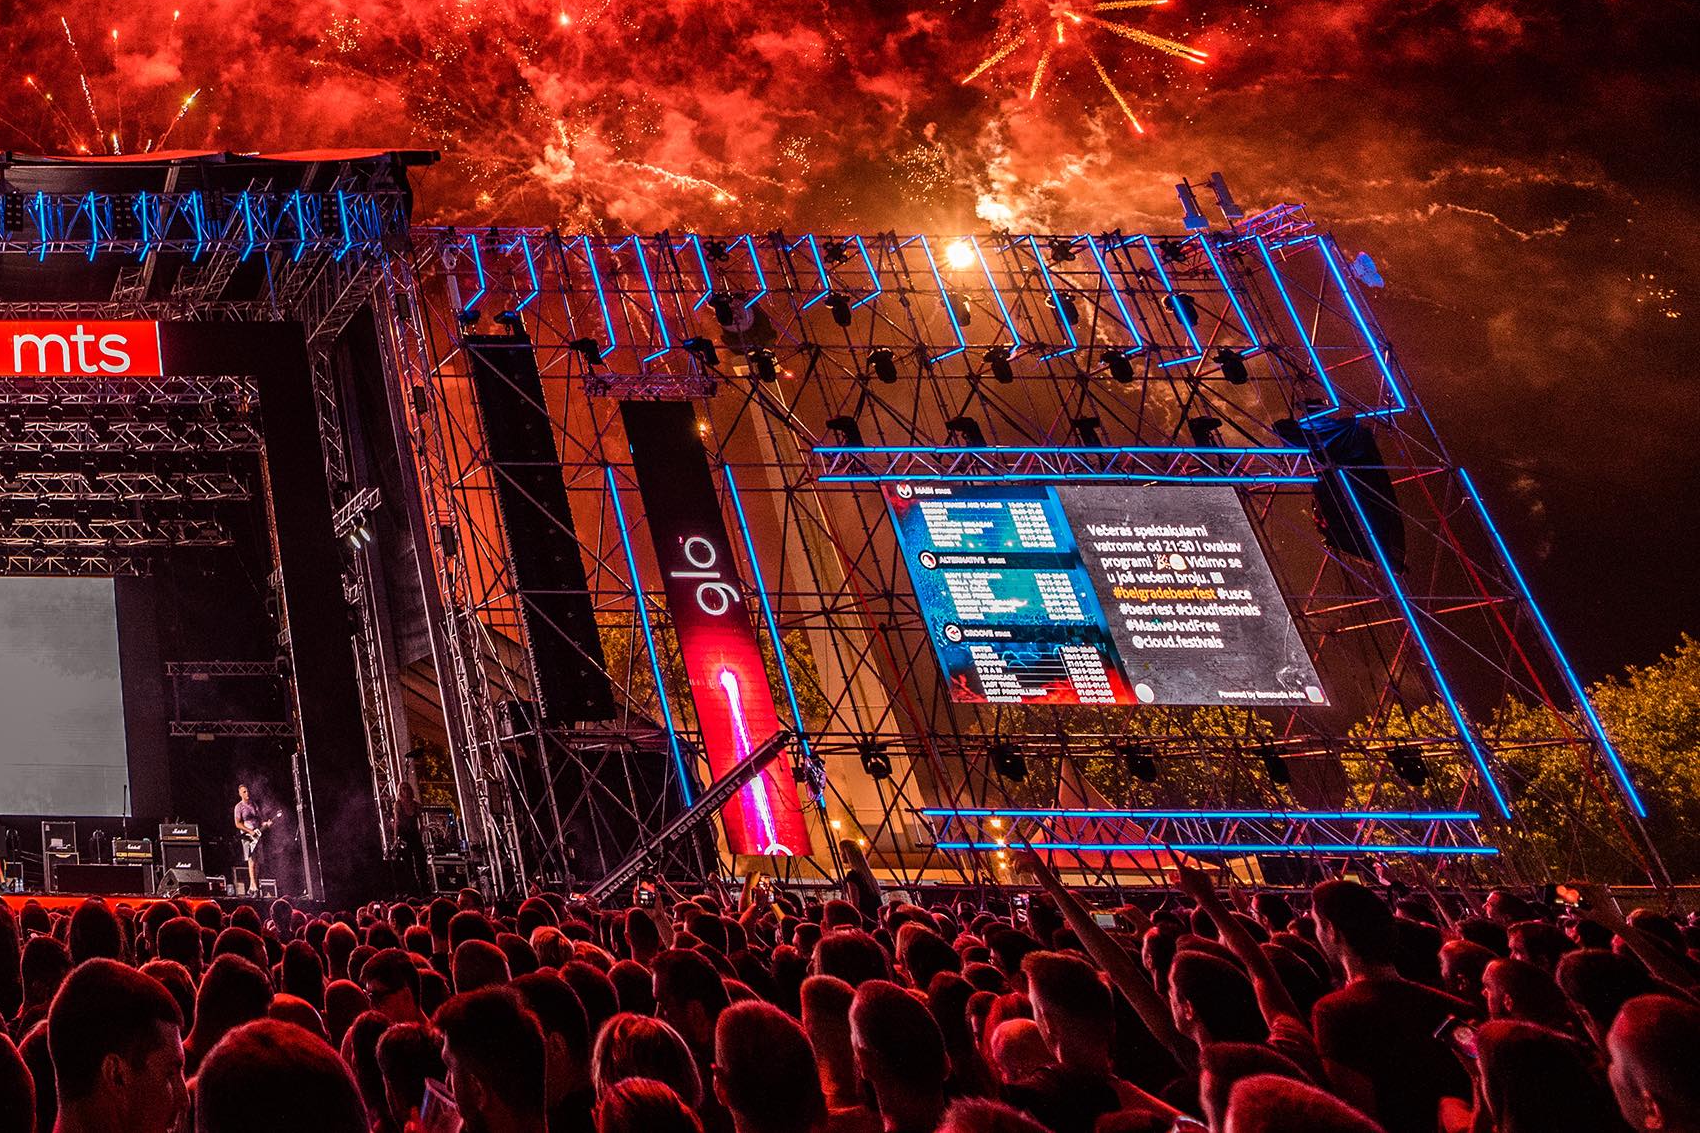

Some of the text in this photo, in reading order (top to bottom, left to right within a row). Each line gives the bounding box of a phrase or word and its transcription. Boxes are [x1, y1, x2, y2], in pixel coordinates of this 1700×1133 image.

[14, 324, 131, 373] mts
[1086, 524, 1208, 539] Večeras spektakularni
[1093, 541, 1146, 552] vatromet
[1147, 540, 1162, 552] od
[1162, 540, 1195, 552] 21:30
[1203, 540, 1241, 552] ovakav
[939, 556, 986, 564] ALTERNATIVE
[1186, 556, 1226, 568] Vidimo
[1228, 559, 1242, 568] se
[1107, 573, 1116, 583] u
[1117, 572, 1136, 586] još
[1174, 571, 1210, 586] broju.
[1113, 587, 1217, 602] #belgradebeerfest
[1119, 603, 1261, 616] #beerfest #cloudfestivals
[964, 630, 994, 638] GROOVE
[1132, 635, 1224, 648] @cloud.festivals
[596, 776, 742, 905] ANNER EGRIPMENT
